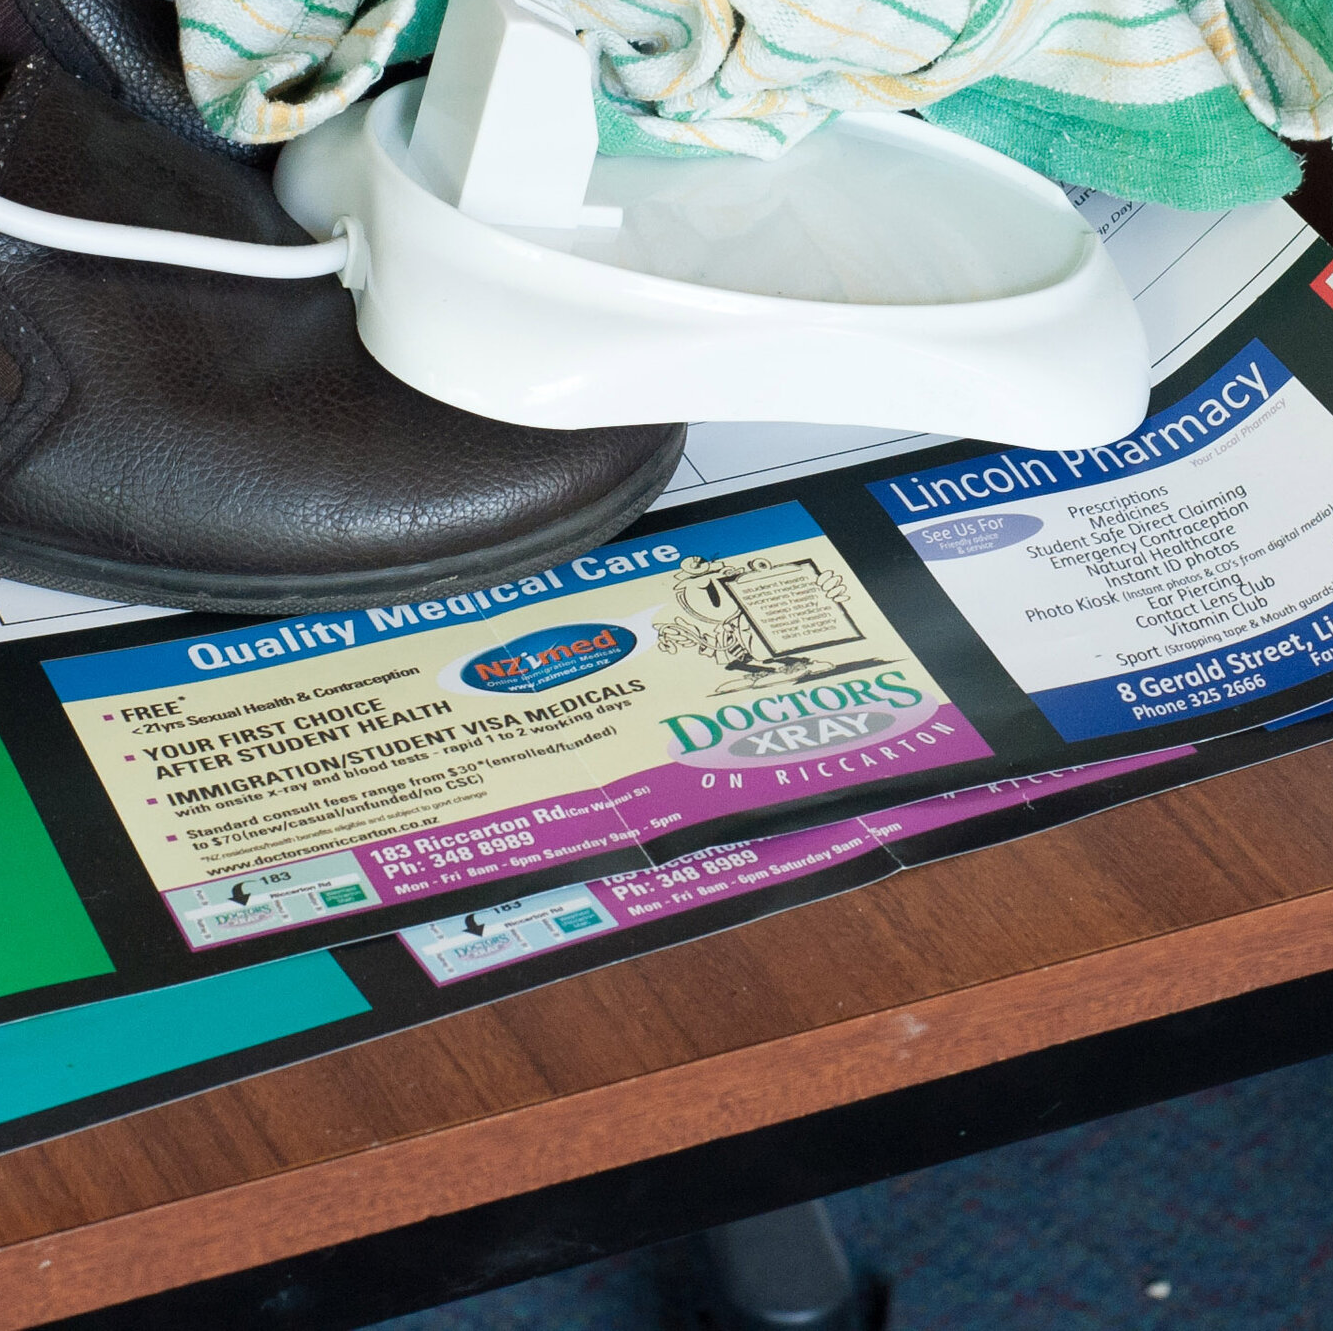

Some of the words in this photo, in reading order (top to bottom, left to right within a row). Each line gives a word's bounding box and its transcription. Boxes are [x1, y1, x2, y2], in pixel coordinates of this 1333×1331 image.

[1111, 201, 1134, 224] Day
[889, 454, 1058, 514] Lincoln
[1057, 361, 1271, 481] Pharmacy
[1189, 449, 1214, 468] Your
[1214, 433, 1241, 456] Local
[1240, 396, 1287, 439] Pharmacy
[922, 530, 952, 544] See
[953, 523, 977, 536] Us
[978, 518, 1004, 532] For
[1026, 537, 1092, 559] Student
[1091, 526, 1127, 545] Safe
[1128, 514, 1176, 536] Direct
[1178, 484, 1248, 520] Claiming
[1067, 485, 1169, 519] Prescriptions
[1089, 500, 1170, 530] Medicines
[1049, 543, 1137, 570] Emergency
[1139, 500, 1250, 548] Contraception
[1085, 552, 1148, 577] Natural
[1149, 523, 1237, 562] Healthcare
[1105, 564, 1163, 589] Instant
[1163, 558, 1182, 574] ID
[1187, 539, 1241, 570] photos
[186, 615, 357, 672] Quality
[364, 568, 565, 633] Medical
[570, 541, 683, 583] Care
[1025, 602, 1074, 623] Photo
[1075, 591, 1120, 612] Kiosk
[1122, 583, 1165, 602] (Instant
[1166, 573, 1204, 592] photos
[1204, 568, 1214, 578] &
[1215, 560, 1240, 574] CD's
[1240, 548, 1266, 567] from
[1267, 527, 1300, 552] digital
[1135, 603, 1198, 629] Contact
[1201, 588, 1238, 611] Lens
[1240, 575, 1276, 598] Club
[1147, 595, 1174, 610] Ear
[1176, 572, 1244, 602] Piercing
[1116, 646, 1162, 667] Sport
[1164, 629, 1223, 657] (Strapping
[1223, 623, 1248, 639] tape
[1249, 619, 1259, 629] &
[1260, 604, 1298, 624] Mouth
[1164, 610, 1230, 637] Vitamin
[1231, 595, 1269, 617] Club
[186, 707, 242, 727] Sexual
[243, 695, 295, 714] Health
[296, 691, 311, 702] &
[313, 665, 420, 699] Contraception
[1116, 682, 1137, 704] 8
[1139, 659, 1226, 698] Gerald
[1226, 633, 1315, 674] Street,
[1132, 698, 1188, 721] Phone
[1190, 689, 1222, 708] 325
[1222, 673, 1267, 699] 2666
[143, 737, 215, 762] YOUR
[218, 720, 287, 748] FIRST
[292, 697, 387, 731] CHOICE
[155, 753, 234, 781] AFTER
[236, 723, 358, 763] STUDENT
[357, 700, 453, 734] HEALTH
[166, 726, 457, 807] IMMIGRATION/STUDENT
[461, 714, 523, 738] VISA
[523, 678, 646, 724] MEDICALS
[658, 670, 923, 756] DOCTORS
[745, 712, 869, 756] XRAY
[174, 803, 212, 818] with
[216, 791, 263, 810] onsite
[267, 782, 308, 800] x-ray
[312, 773, 341, 789] and
[345, 760, 388, 779] blood
[390, 751, 430, 768] tests
[443, 736, 483, 756] rapid
[501, 730, 514, 742] to
[516, 727, 528, 738] 2
[530, 710, 595, 736] working
[596, 698, 633, 717] days
[700, 772, 743, 789] ON
[775, 721, 956, 786] RICCARTON
[186, 814, 259, 840] Standard
[262, 800, 321, 823] consult
[322, 790, 358, 807] fees
[361, 781, 406, 803] range
[409, 770, 446, 788] from
[192, 840, 209, 851] to
[445, 774, 485, 796] CSC)
[370, 844, 412, 864] 183
[415, 816, 530, 854] Riccarton
[532, 804, 567, 825] Rd
[258, 871, 292, 886] 183
[382, 859, 426, 880] Ph:
[428, 845, 474, 870] 348
[477, 830, 536, 855] 8989
[394, 881, 429, 897] Mon
[440, 870, 462, 885] Fri
[467, 863, 499, 878] 8am
[509, 853, 542, 870] 6pm
[543, 835, 609, 860] Saturday
[609, 825, 641, 843] 9am
[648, 811, 683, 830] 5pm
[610, 878, 656, 902] Ph:
[655, 865, 702, 892] 348
[703, 848, 760, 877] 8989
[626, 899, 664, 918] Mon
[673, 889, 693, 906] Fri
[696, 881, 729, 897] 8am
[737, 868, 771, 889] 6pm
[768, 843, 833, 876] Saturday
[831, 834, 864, 855] 9am
[869, 820, 903, 840] 5pm
